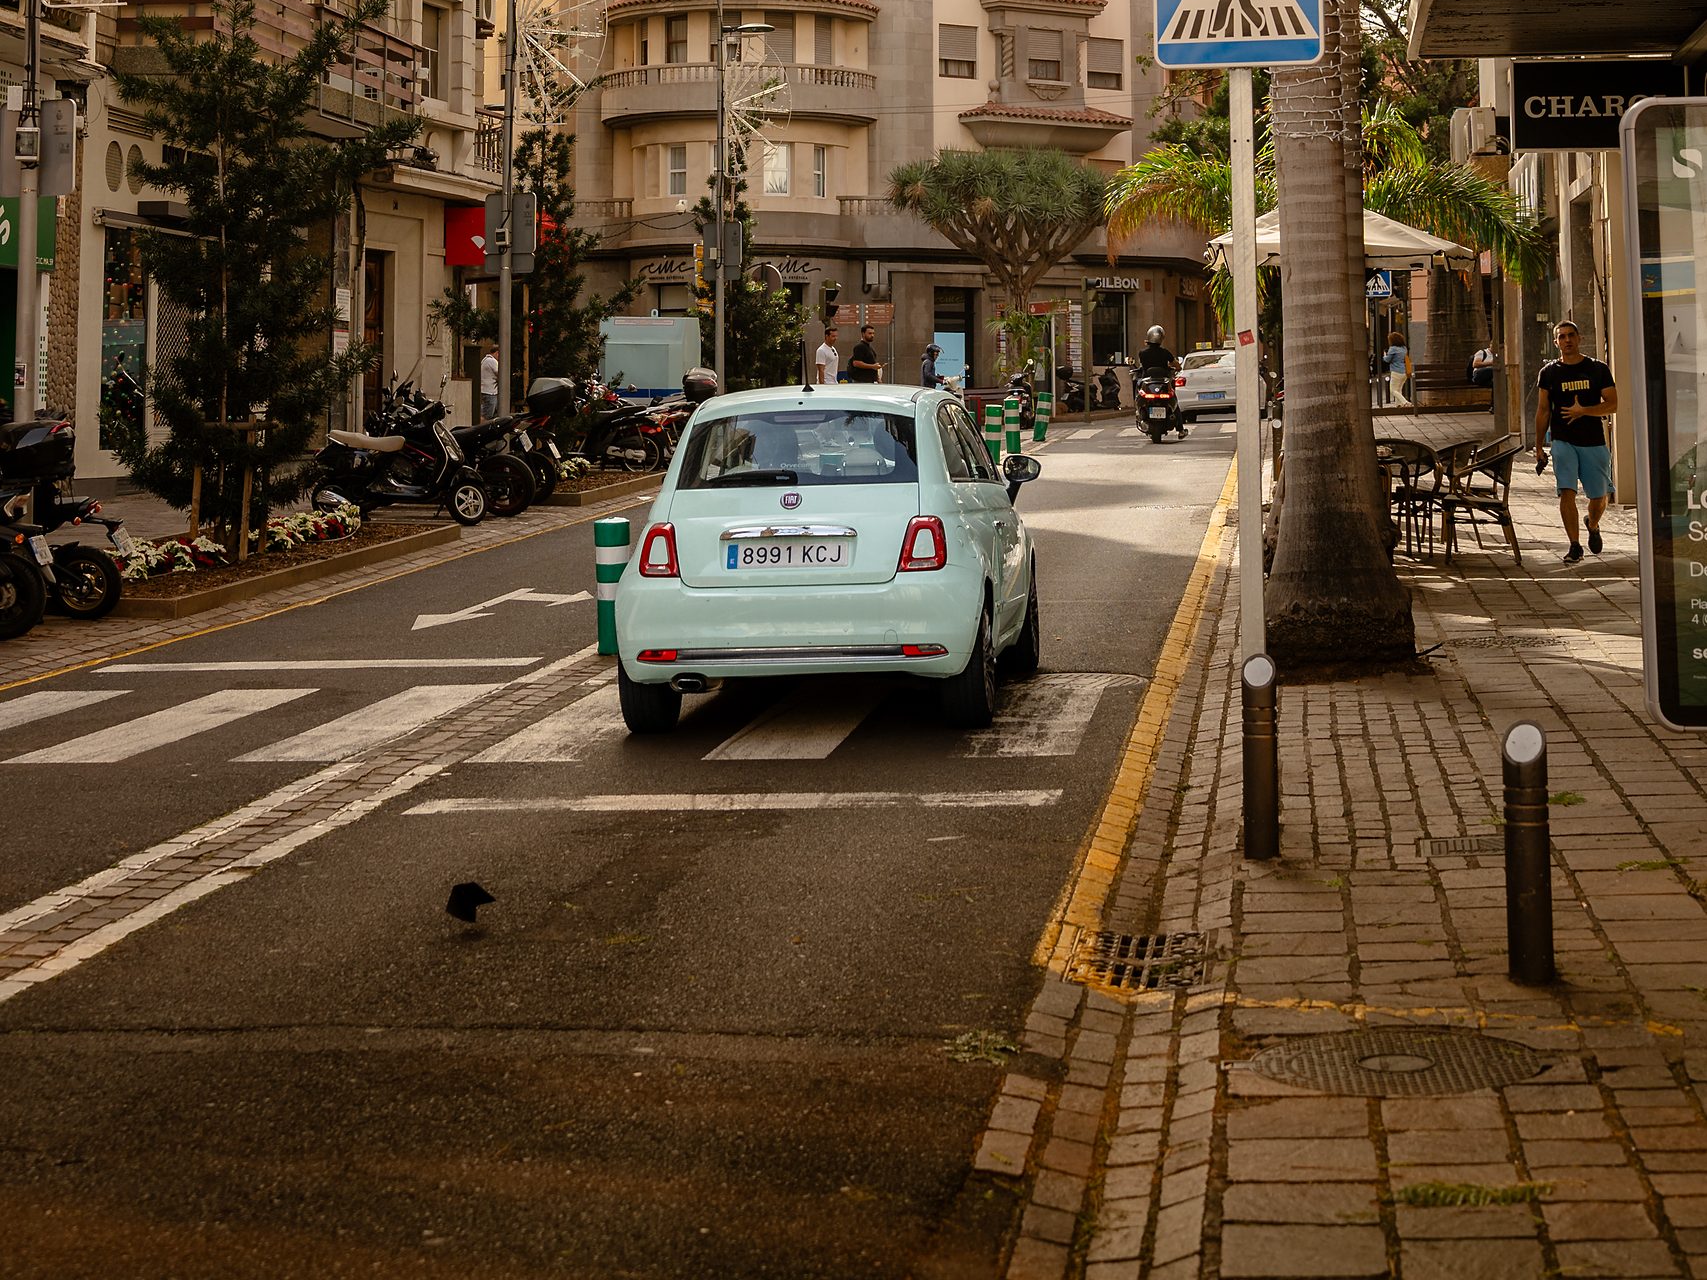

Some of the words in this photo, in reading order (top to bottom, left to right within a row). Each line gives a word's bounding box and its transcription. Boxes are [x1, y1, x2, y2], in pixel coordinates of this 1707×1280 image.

[1523, 94, 1667, 119] CHAR
[1561, 379, 1590, 392] PUMA
[784, 495, 798, 505] FIAT
[742, 545, 792, 565] 8991
[802, 544, 842, 564] KCJ
[1691, 613, 1700, 625] 4
